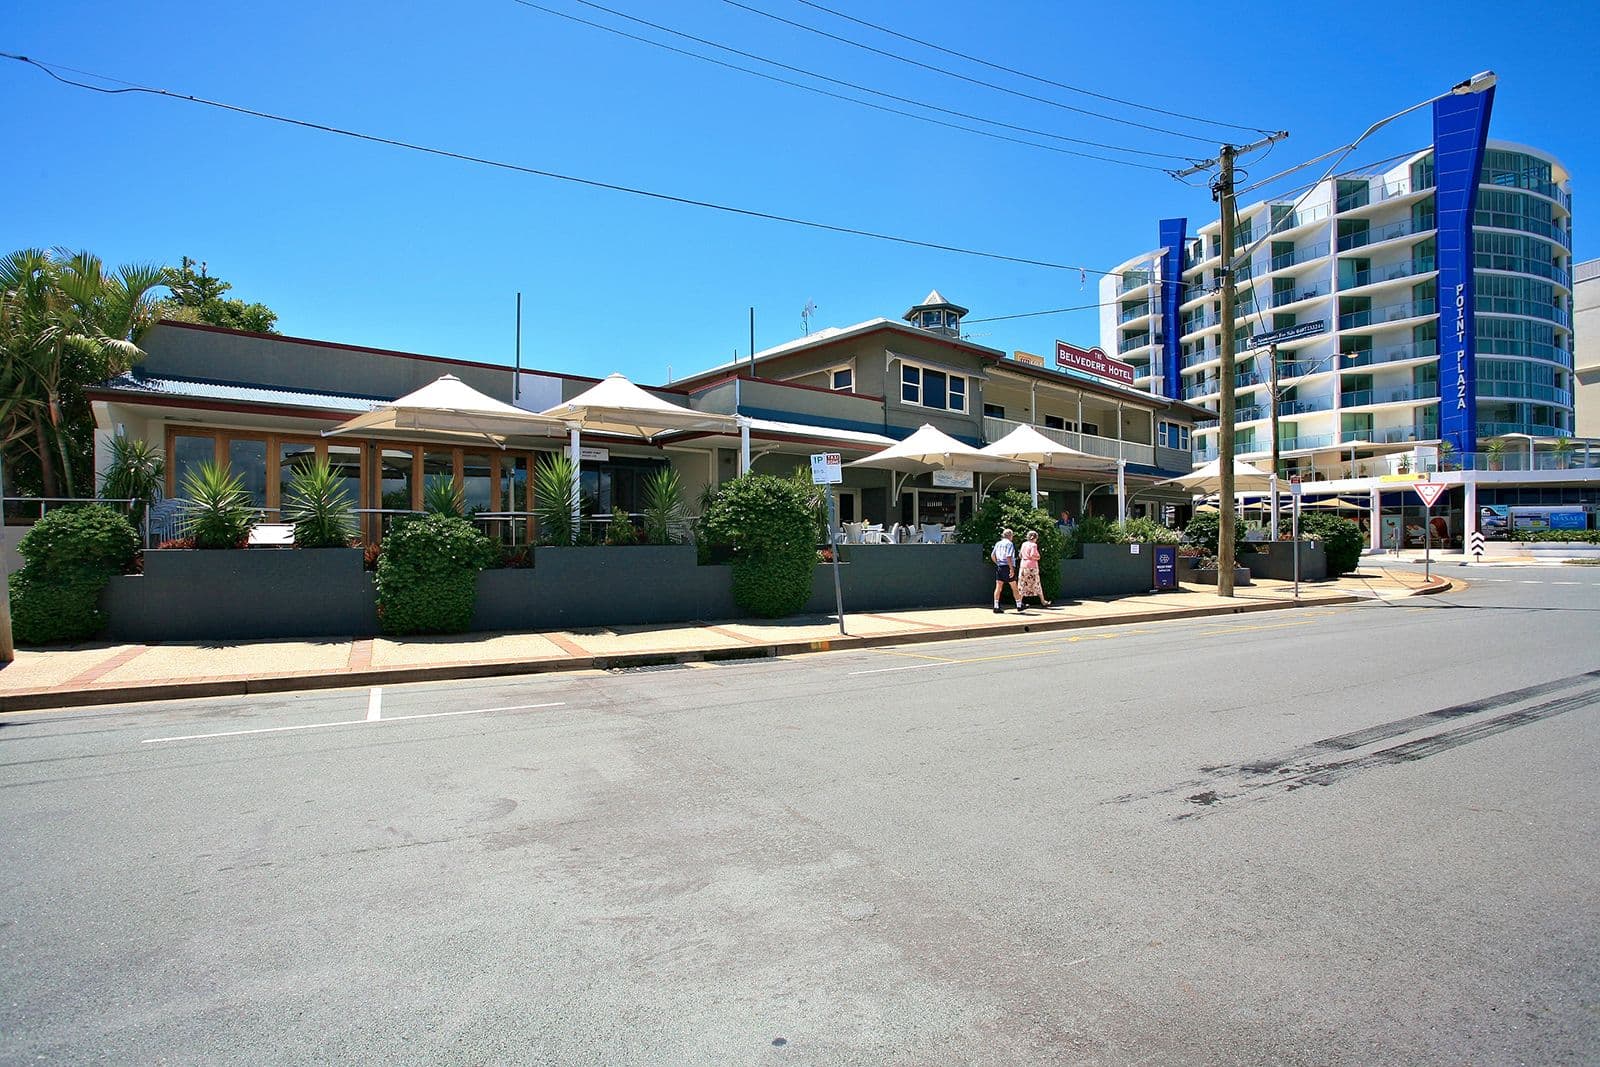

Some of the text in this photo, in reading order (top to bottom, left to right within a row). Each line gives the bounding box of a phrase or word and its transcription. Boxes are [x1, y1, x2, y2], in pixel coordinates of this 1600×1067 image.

[1059, 349, 1106, 372] BELVEDERE
[1108, 365, 1132, 380] HOTEL
[1456, 283, 1466, 410] POINT PLAZA
